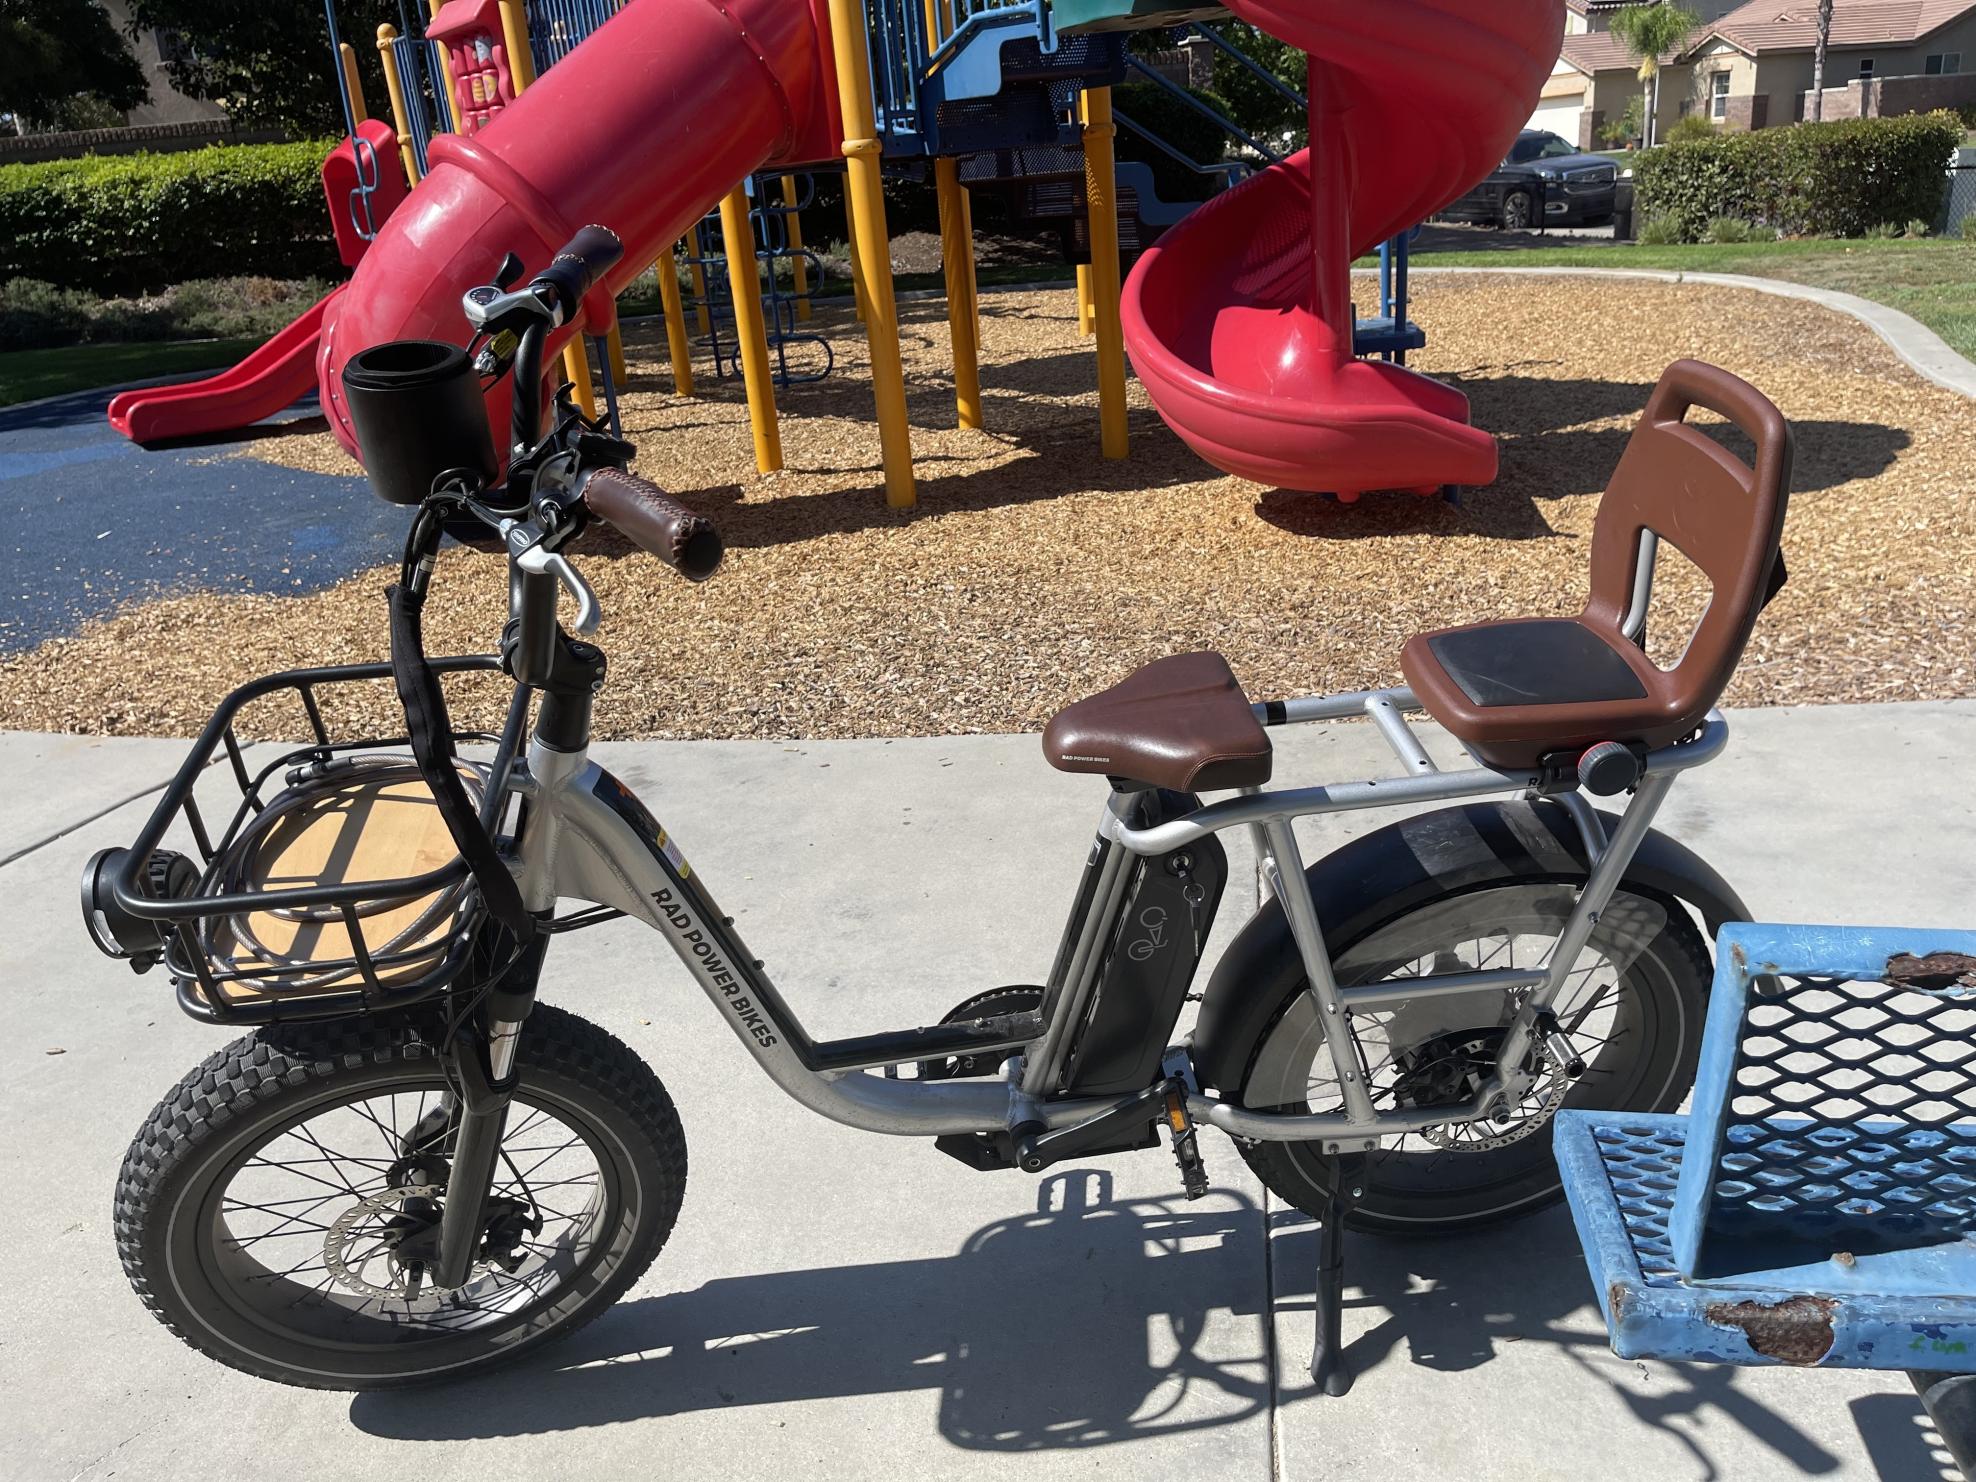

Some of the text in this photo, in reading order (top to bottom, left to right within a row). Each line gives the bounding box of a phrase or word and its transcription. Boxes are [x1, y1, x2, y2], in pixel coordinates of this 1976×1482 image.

[651, 887, 691, 929] RAD
[682, 929, 740, 998] POWER
[730, 997, 777, 1048] BIKES
